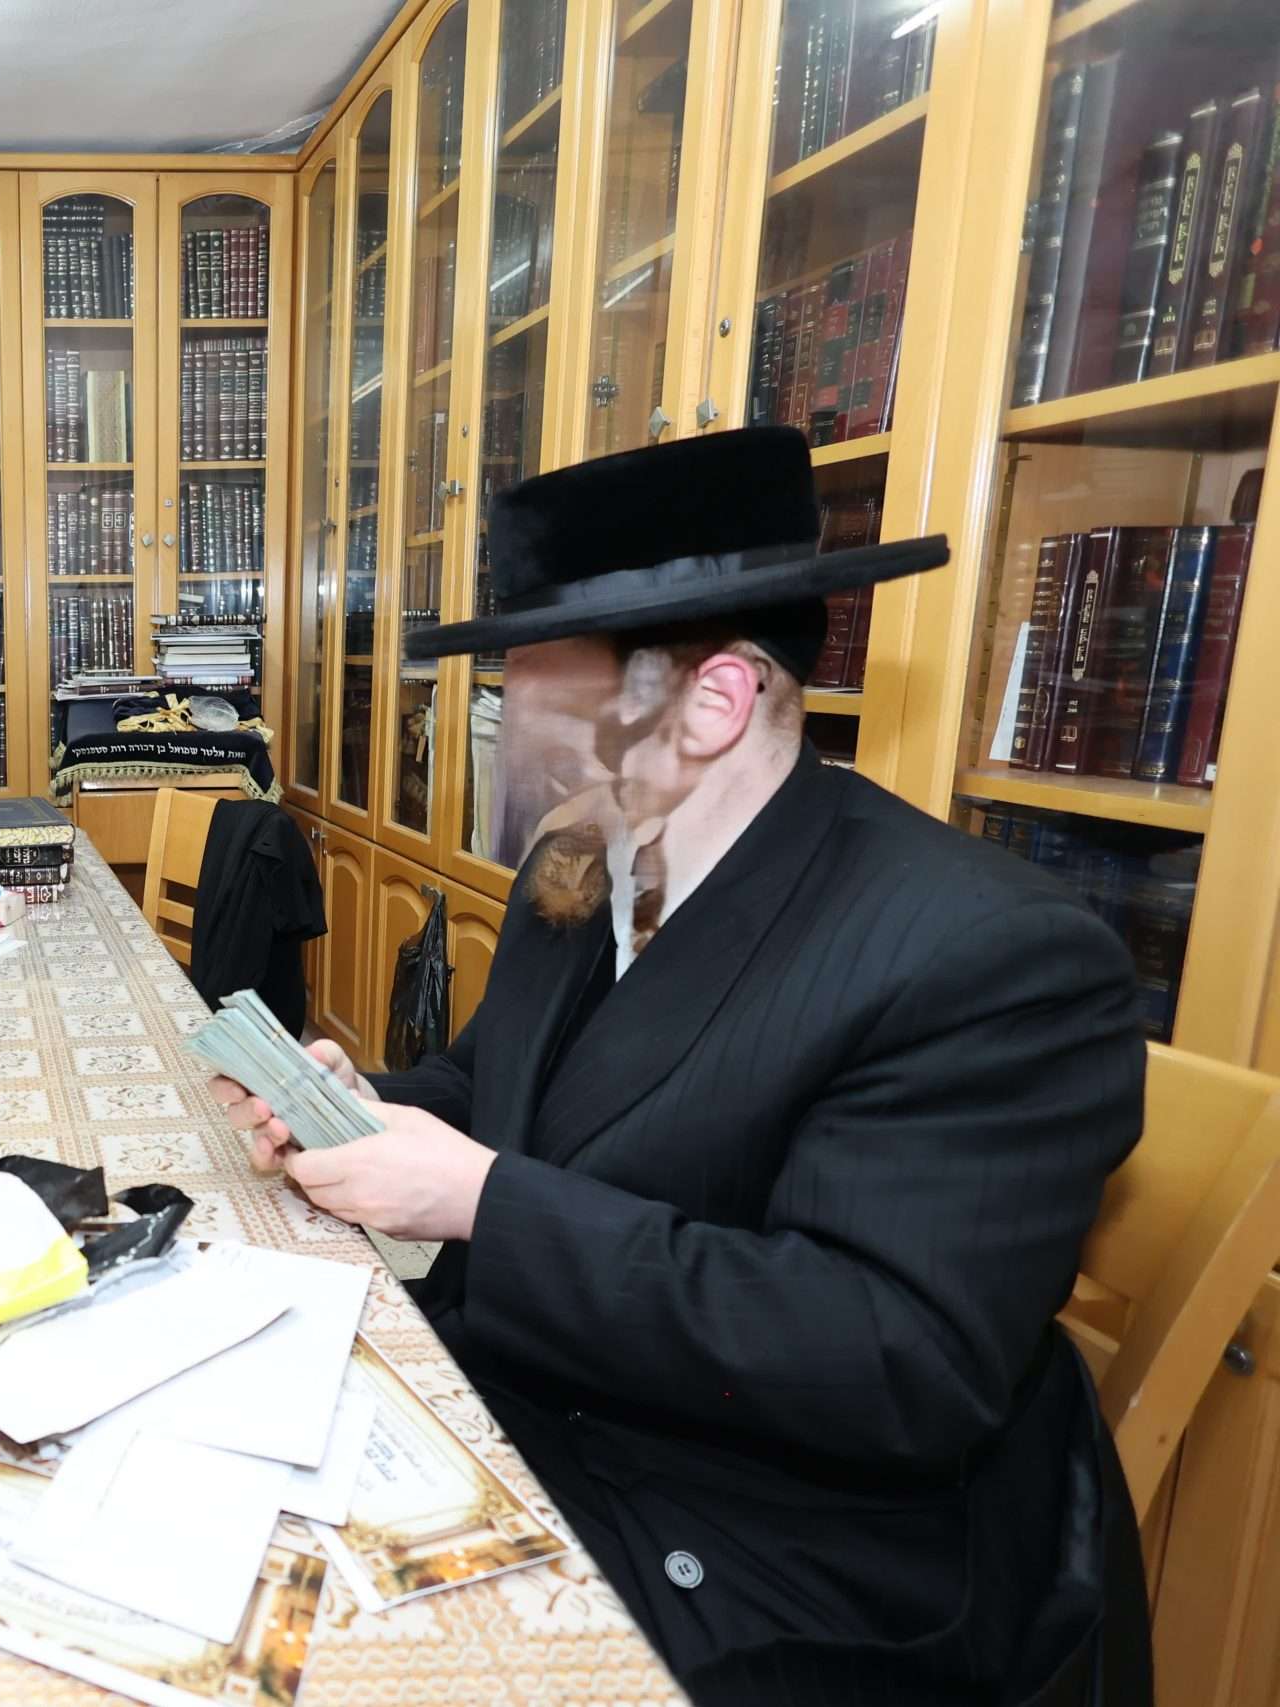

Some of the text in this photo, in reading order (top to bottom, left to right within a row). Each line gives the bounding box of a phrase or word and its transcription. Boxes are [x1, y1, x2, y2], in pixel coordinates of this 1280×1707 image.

[110, 744, 127, 753] רות
[128, 743, 155, 752] דבורה
[156, 744, 166, 755] בן
[168, 743, 198, 755] שמואל
[200, 746, 225, 758] אלטר
